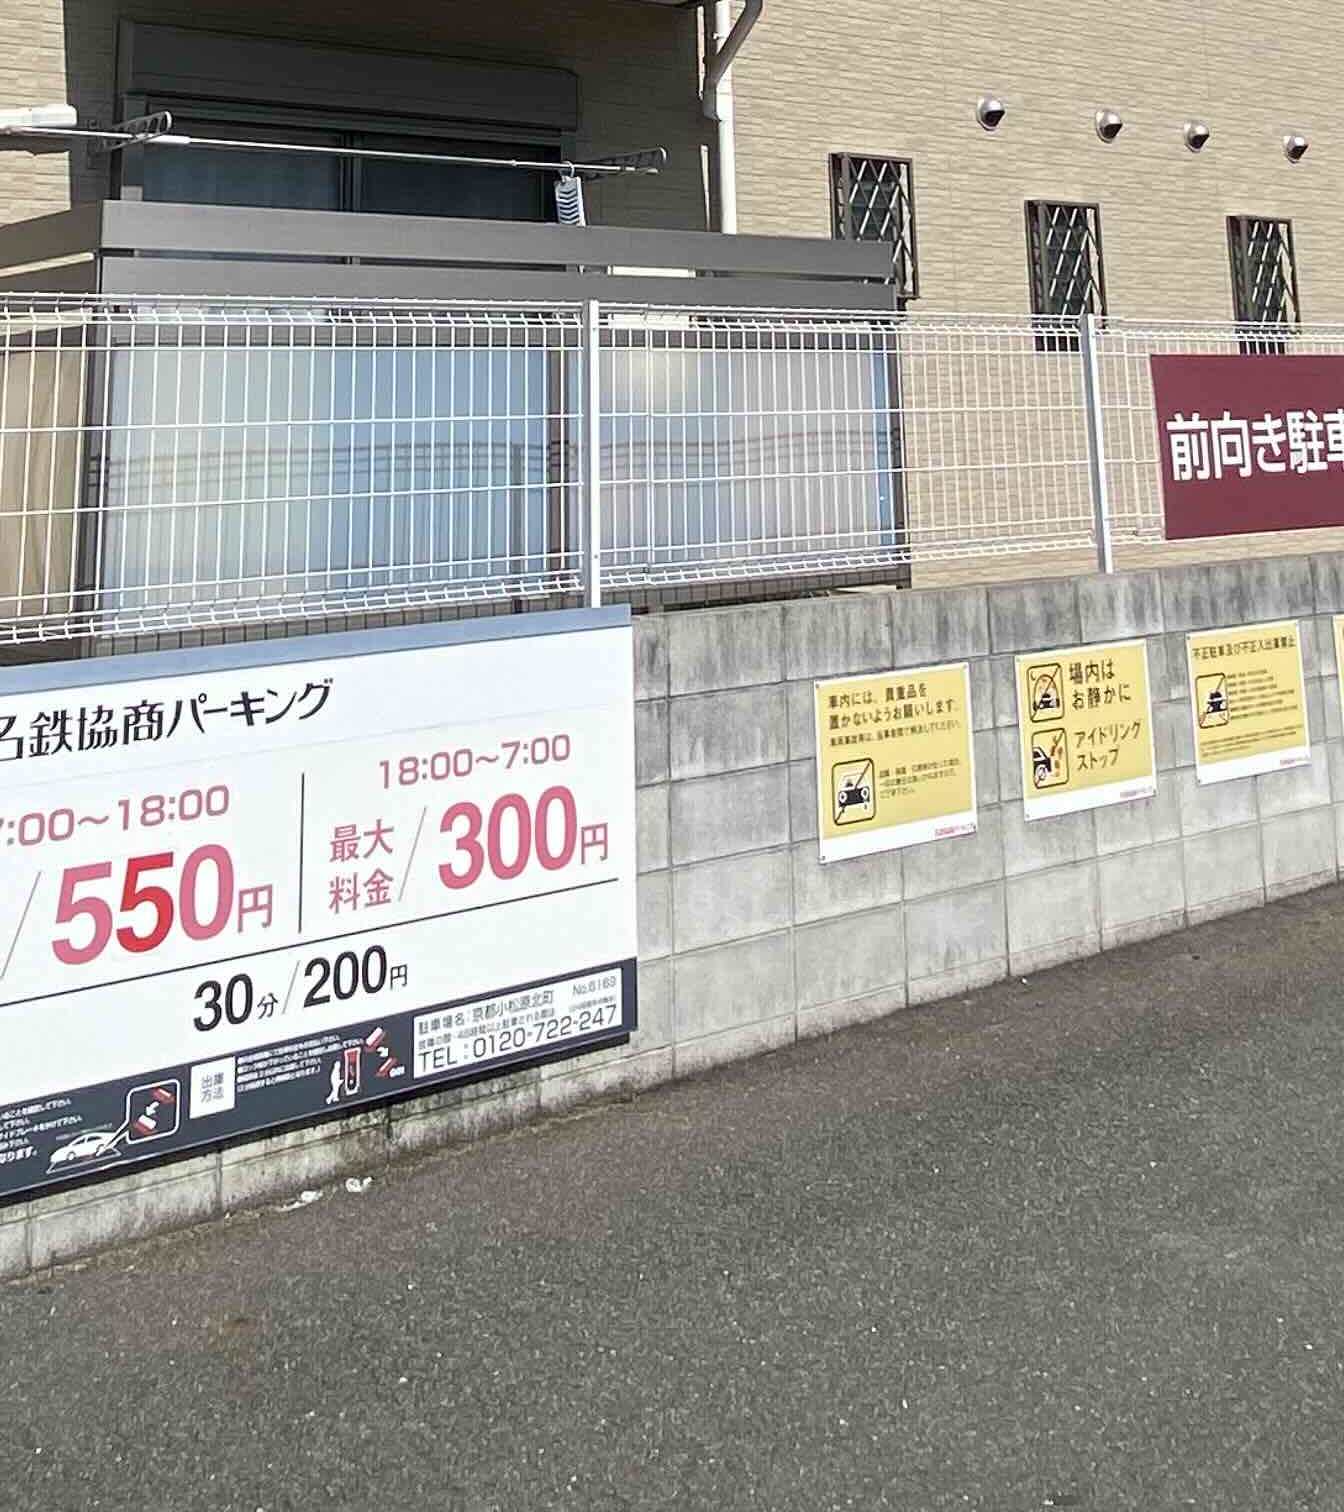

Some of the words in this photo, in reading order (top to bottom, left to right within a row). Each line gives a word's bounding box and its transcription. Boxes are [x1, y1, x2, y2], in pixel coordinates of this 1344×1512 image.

[1069, 658, 1115, 684] 場内は
[1072, 683, 1131, 710] お静かに
[1074, 718, 1142, 748] アイドリング
[1077, 748, 1119, 771] ストップ
[329, 819, 394, 863] 最大
[329, 868, 394, 915] 料金
